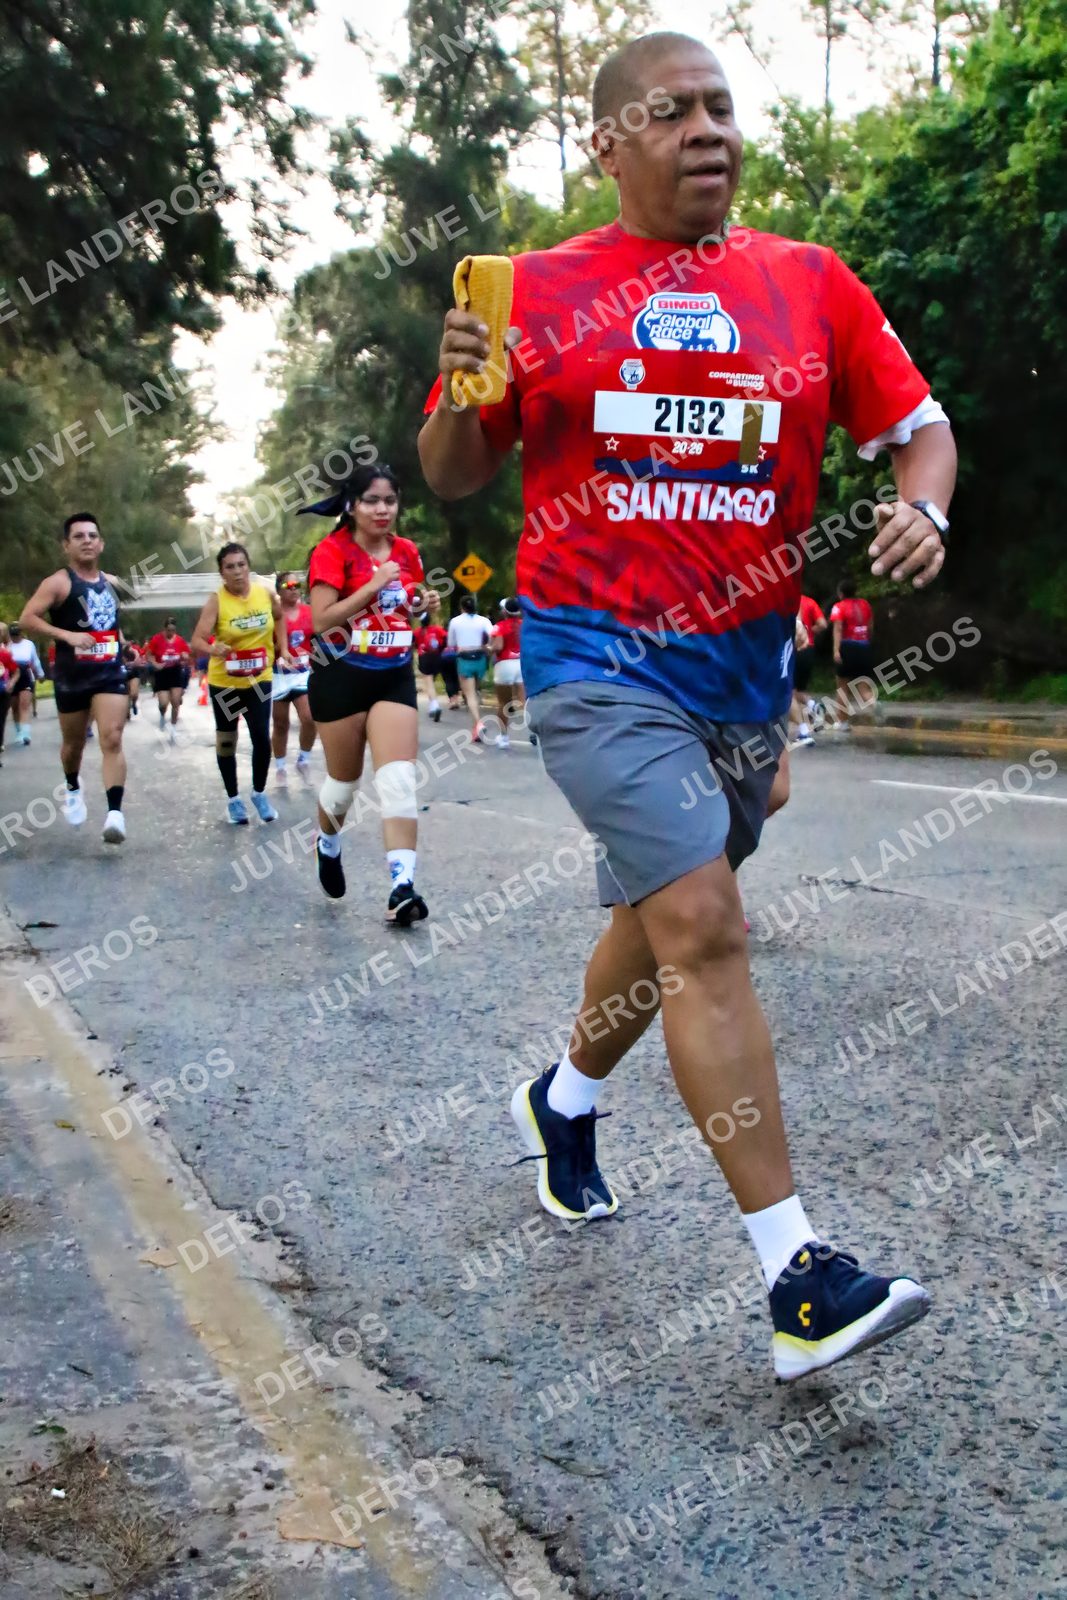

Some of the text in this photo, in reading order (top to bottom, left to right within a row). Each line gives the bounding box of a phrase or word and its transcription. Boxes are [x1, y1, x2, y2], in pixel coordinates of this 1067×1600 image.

[657, 300, 711, 310] BIMBO
[659, 314, 711, 330] Global
[649, 325, 693, 339] Race
[654, 397, 725, 436] 2132
[606, 481, 776, 527] SANTIAGO
[371, 632, 396, 645] 2617
